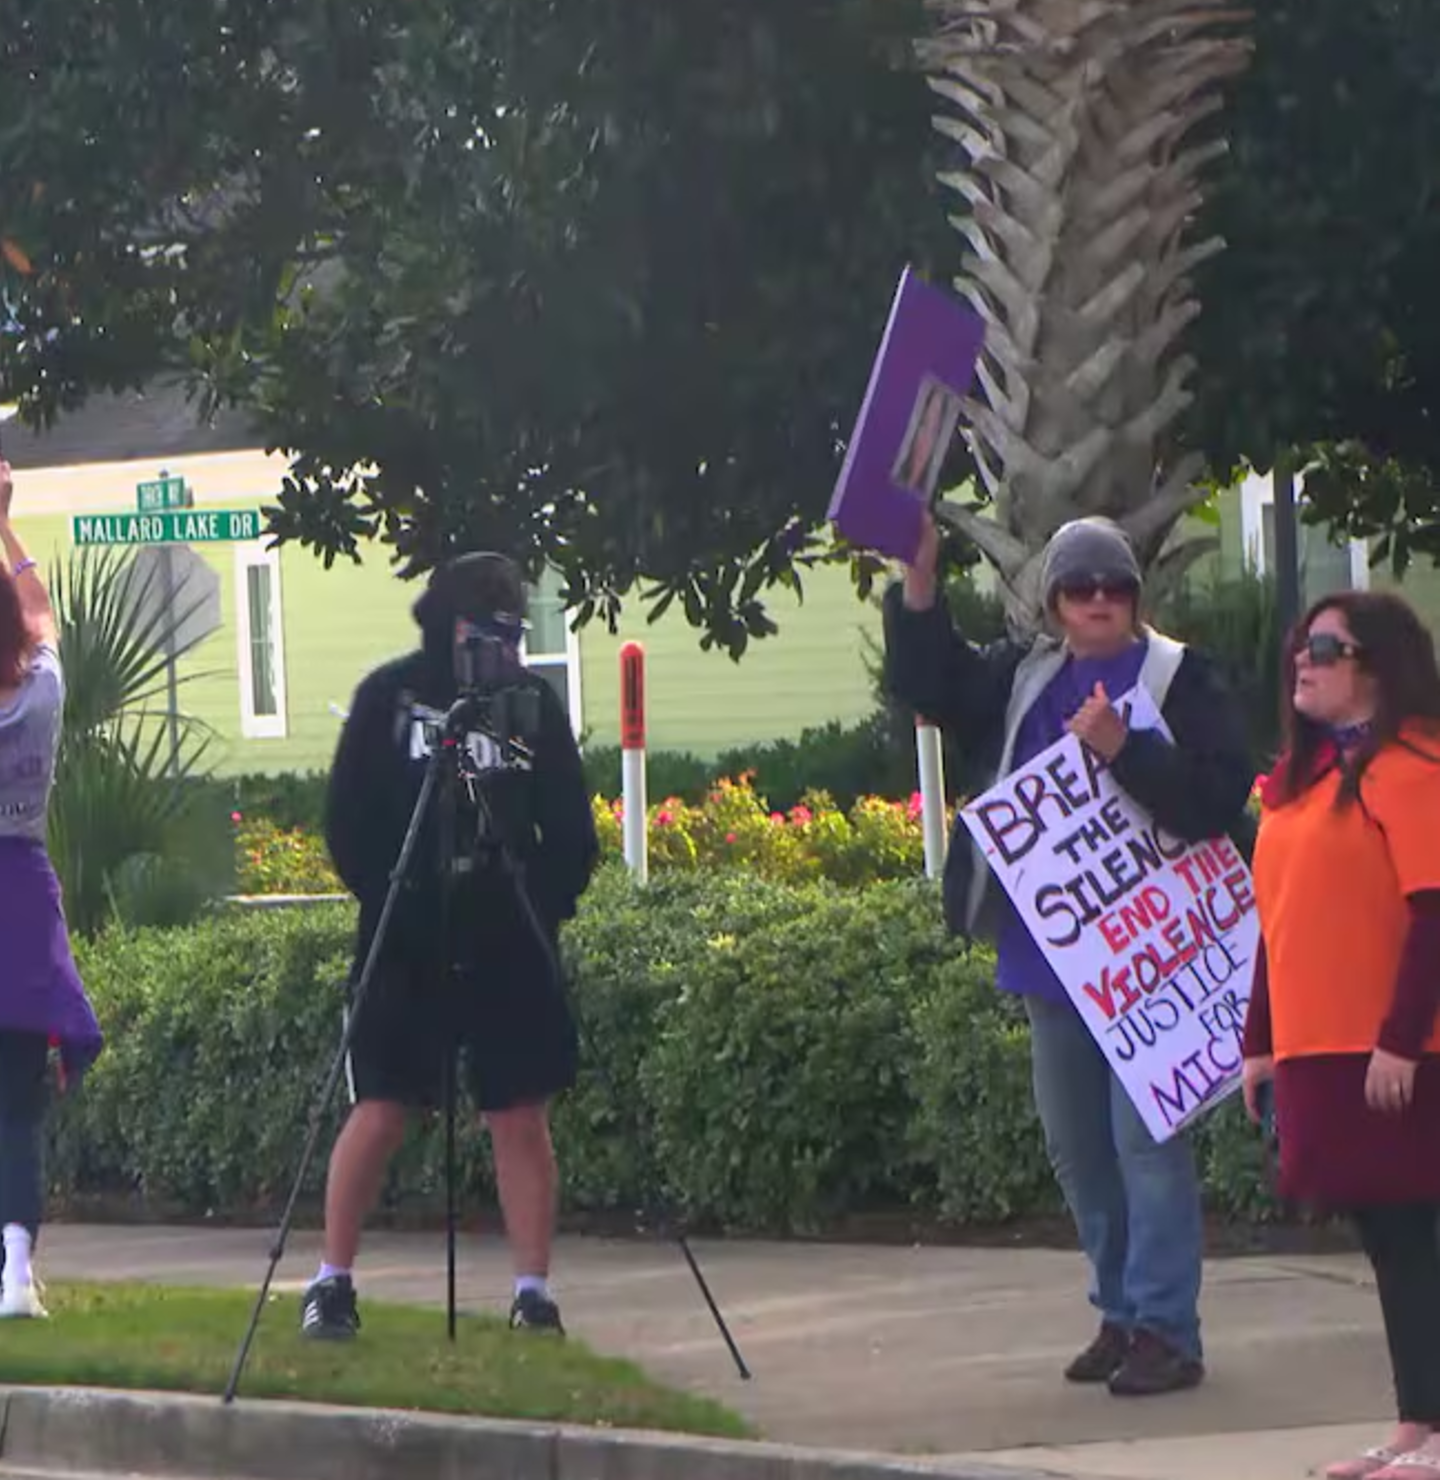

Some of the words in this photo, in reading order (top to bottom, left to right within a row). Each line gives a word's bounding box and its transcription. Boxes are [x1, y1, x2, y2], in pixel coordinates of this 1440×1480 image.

[78, 517, 162, 543] MALLARD
[172, 514, 219, 540] LAKE
[229, 513, 253, 538] DR
[1051, 795, 1131, 865] THE
[1035, 822, 1188, 948] SILENC
[1098, 885, 1171, 955] END
[1082, 867, 1256, 1020] VIOLENCE
[1105, 930, 1249, 1062] JUSTICE
[1198, 989, 1250, 1036] FOR
